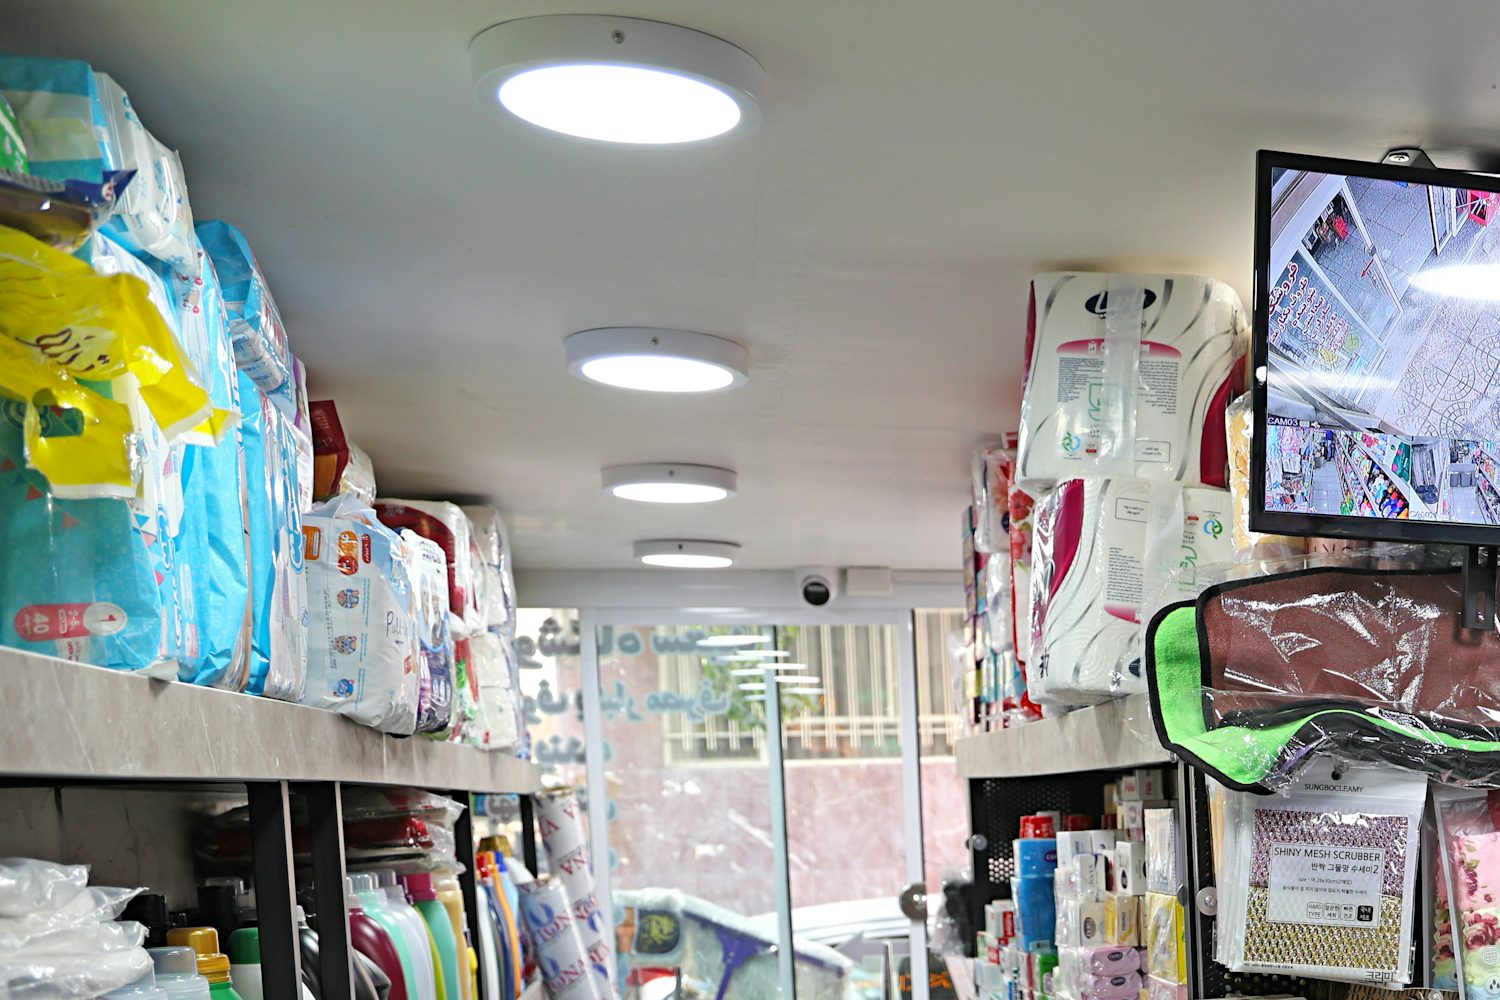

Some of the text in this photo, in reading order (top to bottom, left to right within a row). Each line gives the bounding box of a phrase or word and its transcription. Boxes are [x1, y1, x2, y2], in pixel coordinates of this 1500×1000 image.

[1267, 417, 1299, 426] CAM03
[1304, 784, 1365, 793] SUNGBOCLEAMY
[1274, 847, 1380, 861] SHINY MESH SCRUBBER
[1327, 863, 1350, 874] 그물망
[1351, 864, 1379, 875] 수세미2
